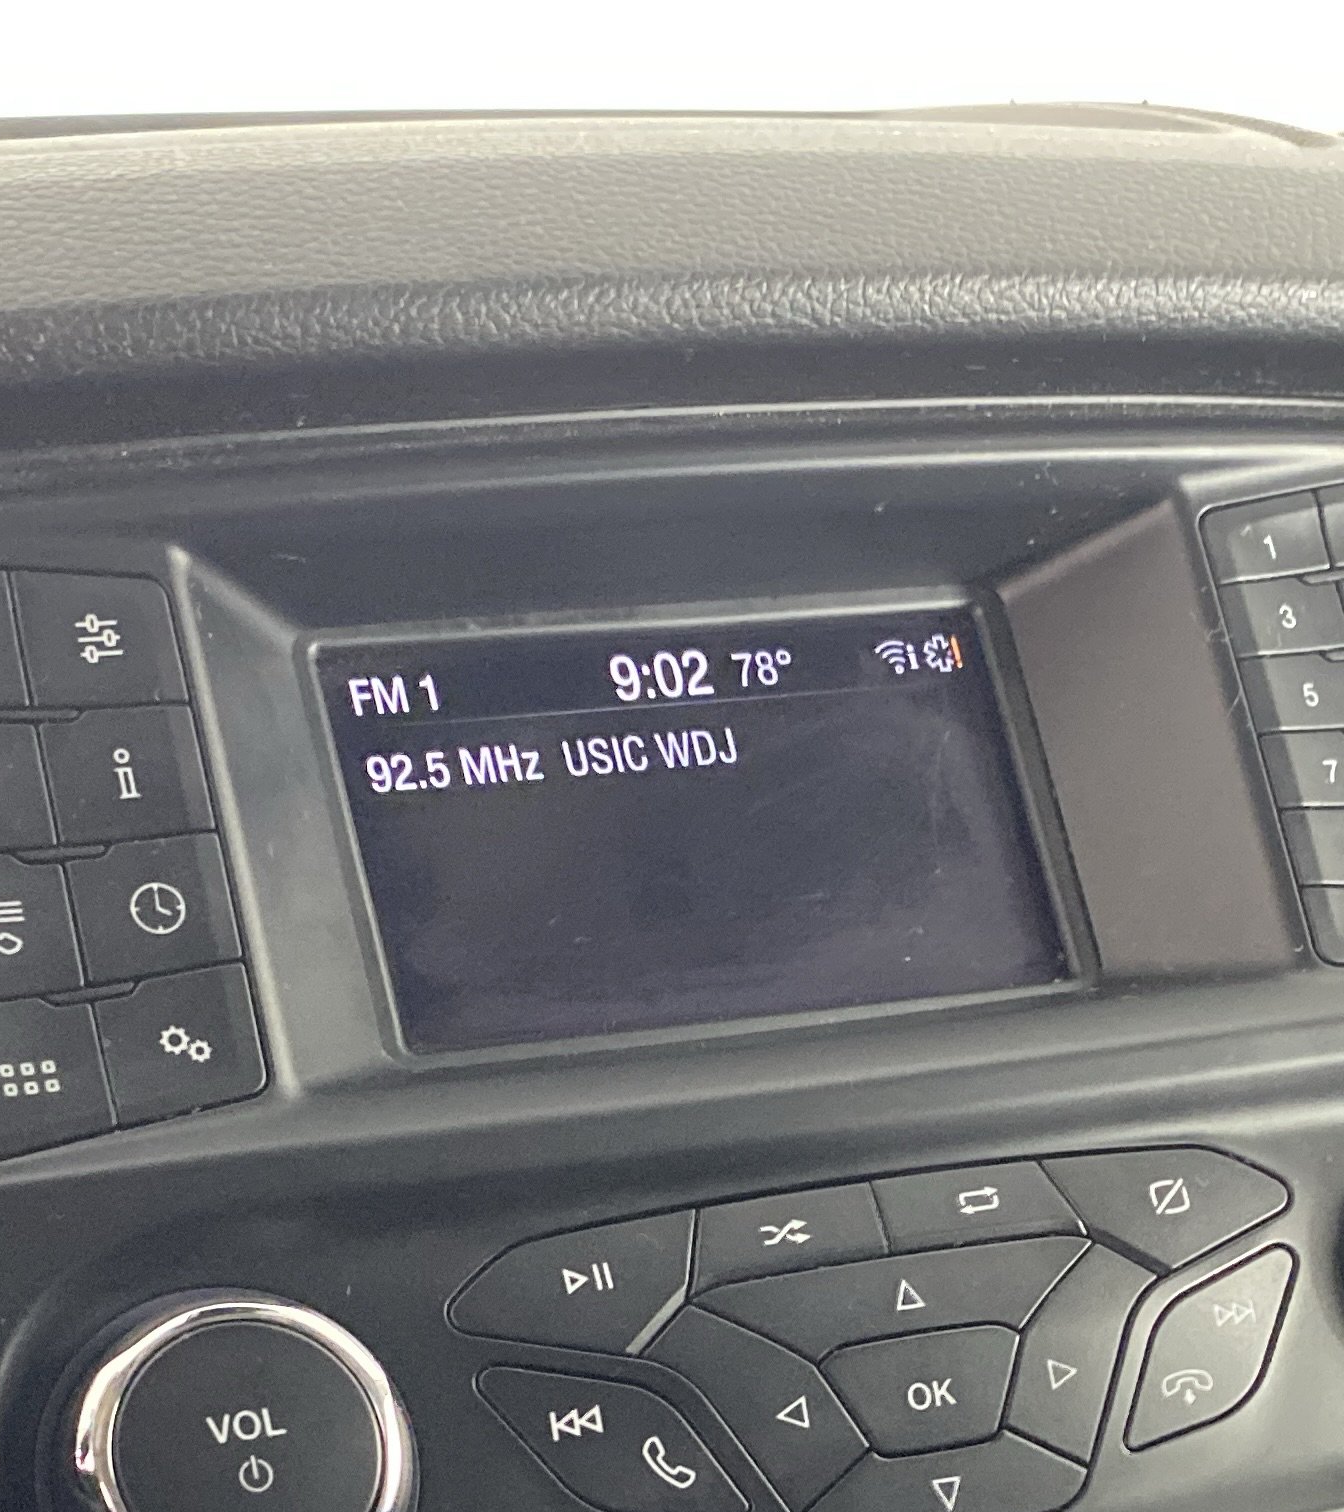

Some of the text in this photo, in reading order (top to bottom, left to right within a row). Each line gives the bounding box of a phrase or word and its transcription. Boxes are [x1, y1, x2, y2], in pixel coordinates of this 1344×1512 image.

[1263, 534, 1277, 560] 1
[1278, 604, 1297, 630] 3
[609, 648, 716, 703] 9:02
[730, 648, 793, 688] 78°
[347, 673, 440, 718] FM 1
[1302, 682, 1320, 708] 5
[365, 726, 739, 794] 92.5 MHz USIC WDJ
[1321, 758, 1338, 785] 7
[906, 1377, 957, 1412] OK
[205, 1406, 288, 1445] VOL
